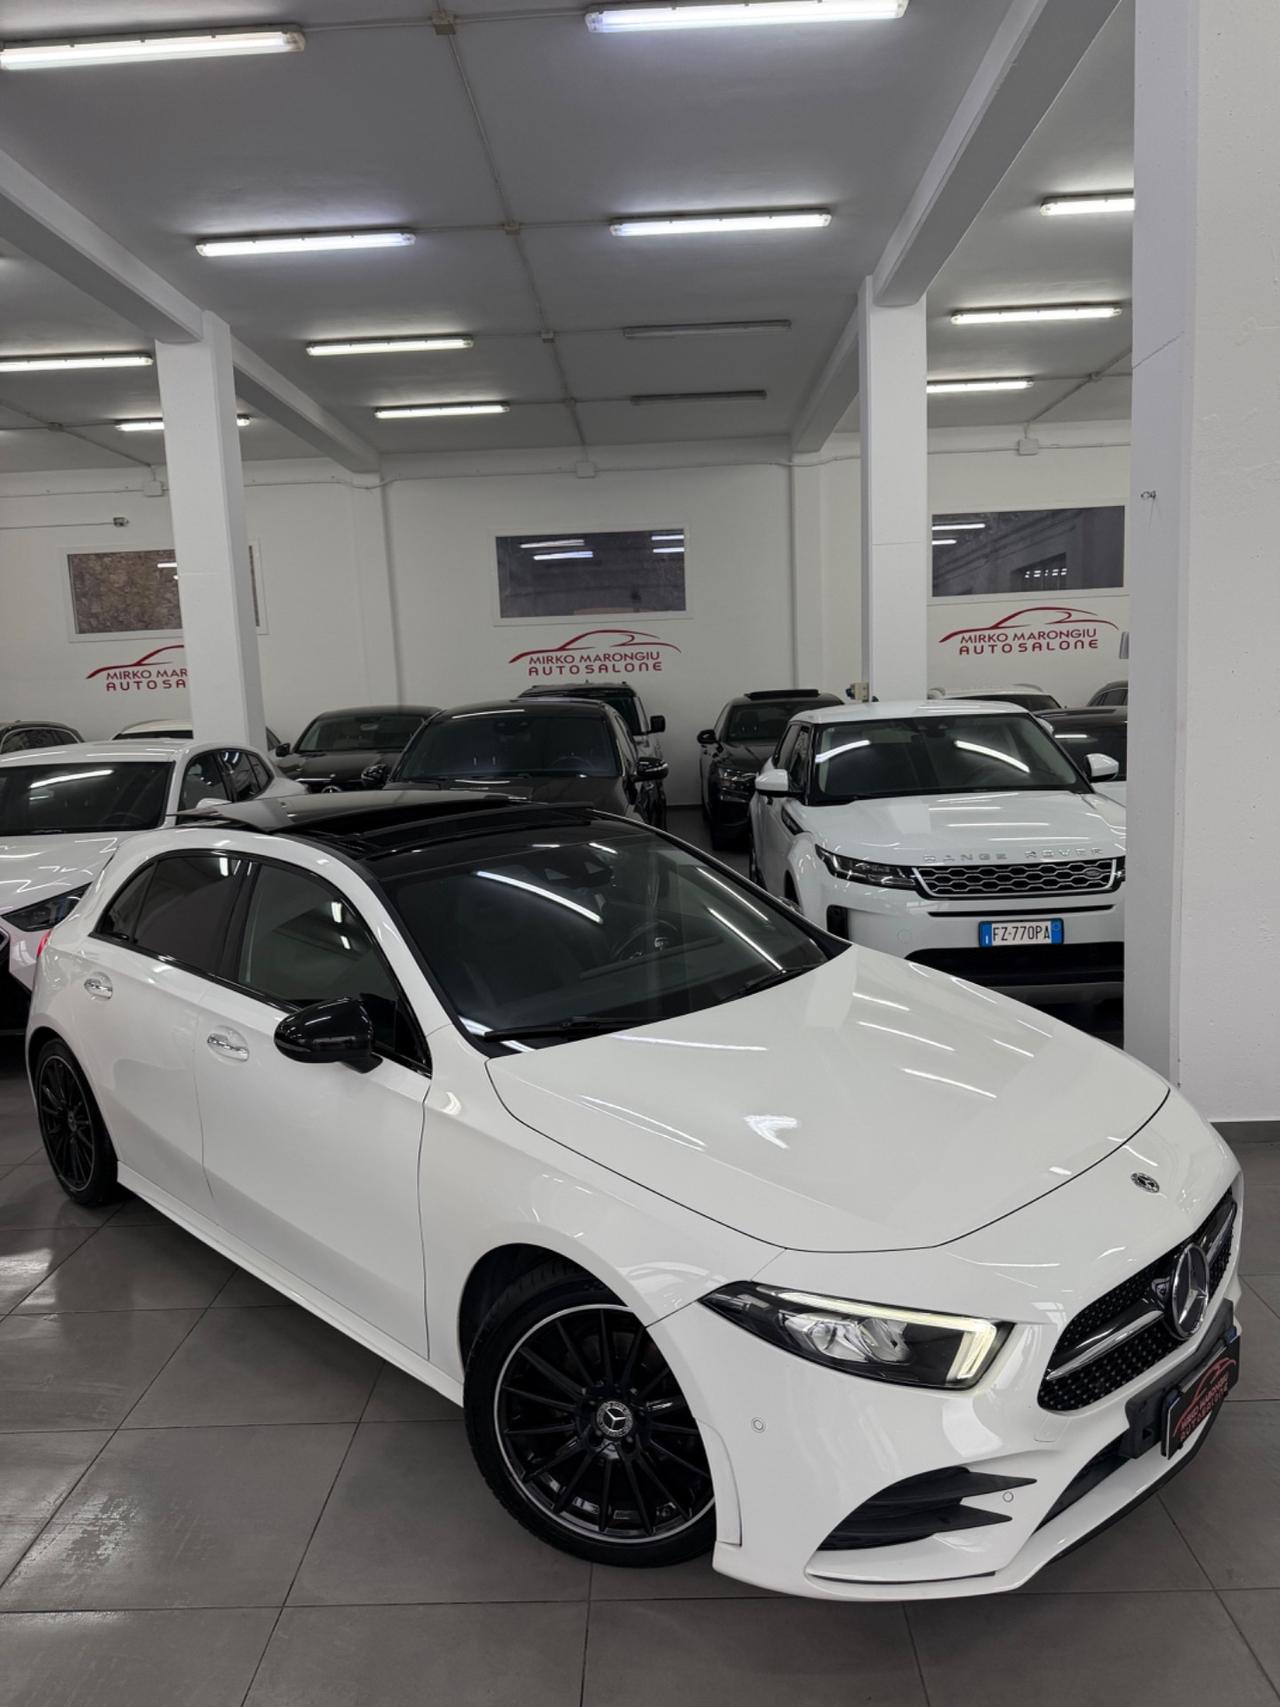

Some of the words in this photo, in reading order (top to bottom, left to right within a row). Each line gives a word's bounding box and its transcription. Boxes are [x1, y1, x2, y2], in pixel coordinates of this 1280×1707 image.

[960, 633, 1008, 644] MIRKO
[1012, 629, 1097, 642] MARONGIU
[959, 639, 1098, 655] AUTOSALONE
[528, 654, 575, 665] MIRKO
[579, 651, 660, 663] MARONGIU
[106, 670, 151, 680] MIRKO
[528, 662, 662, 676] AUTOSALONE
[106, 678, 187, 691] AUTOSA
[923, 853, 1008, 863] RANGE
